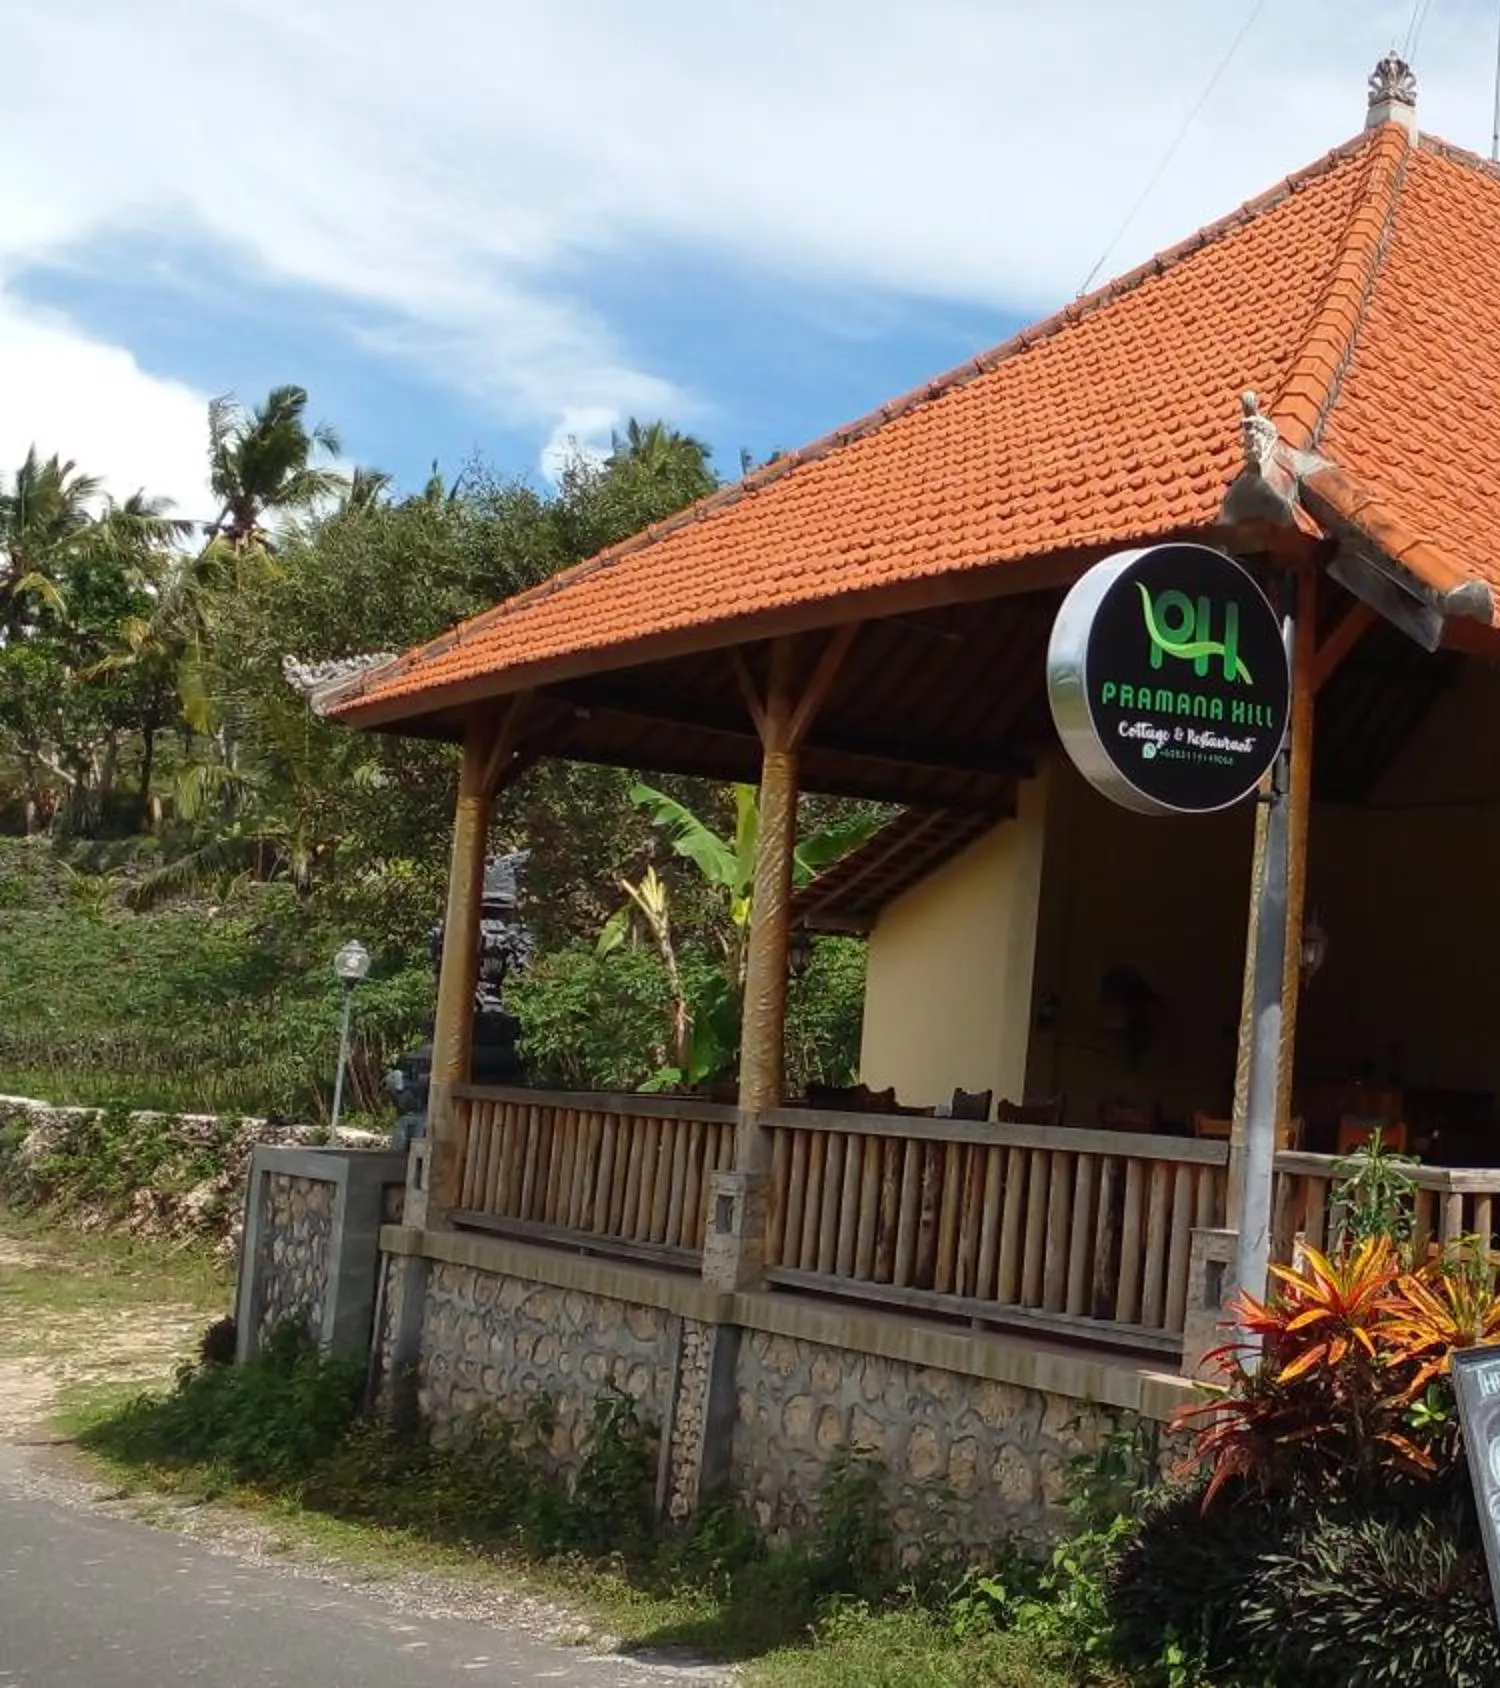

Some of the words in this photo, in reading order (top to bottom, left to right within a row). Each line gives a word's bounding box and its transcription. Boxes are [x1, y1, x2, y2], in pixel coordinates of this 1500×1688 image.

[1102, 681, 1223, 720] PRAMANA
[1231, 699, 1274, 729] HILL
[1118, 720, 1170, 748] Cottage
[1173, 726, 1185, 741] &
[1186, 727, 1257, 753] Restaurant
